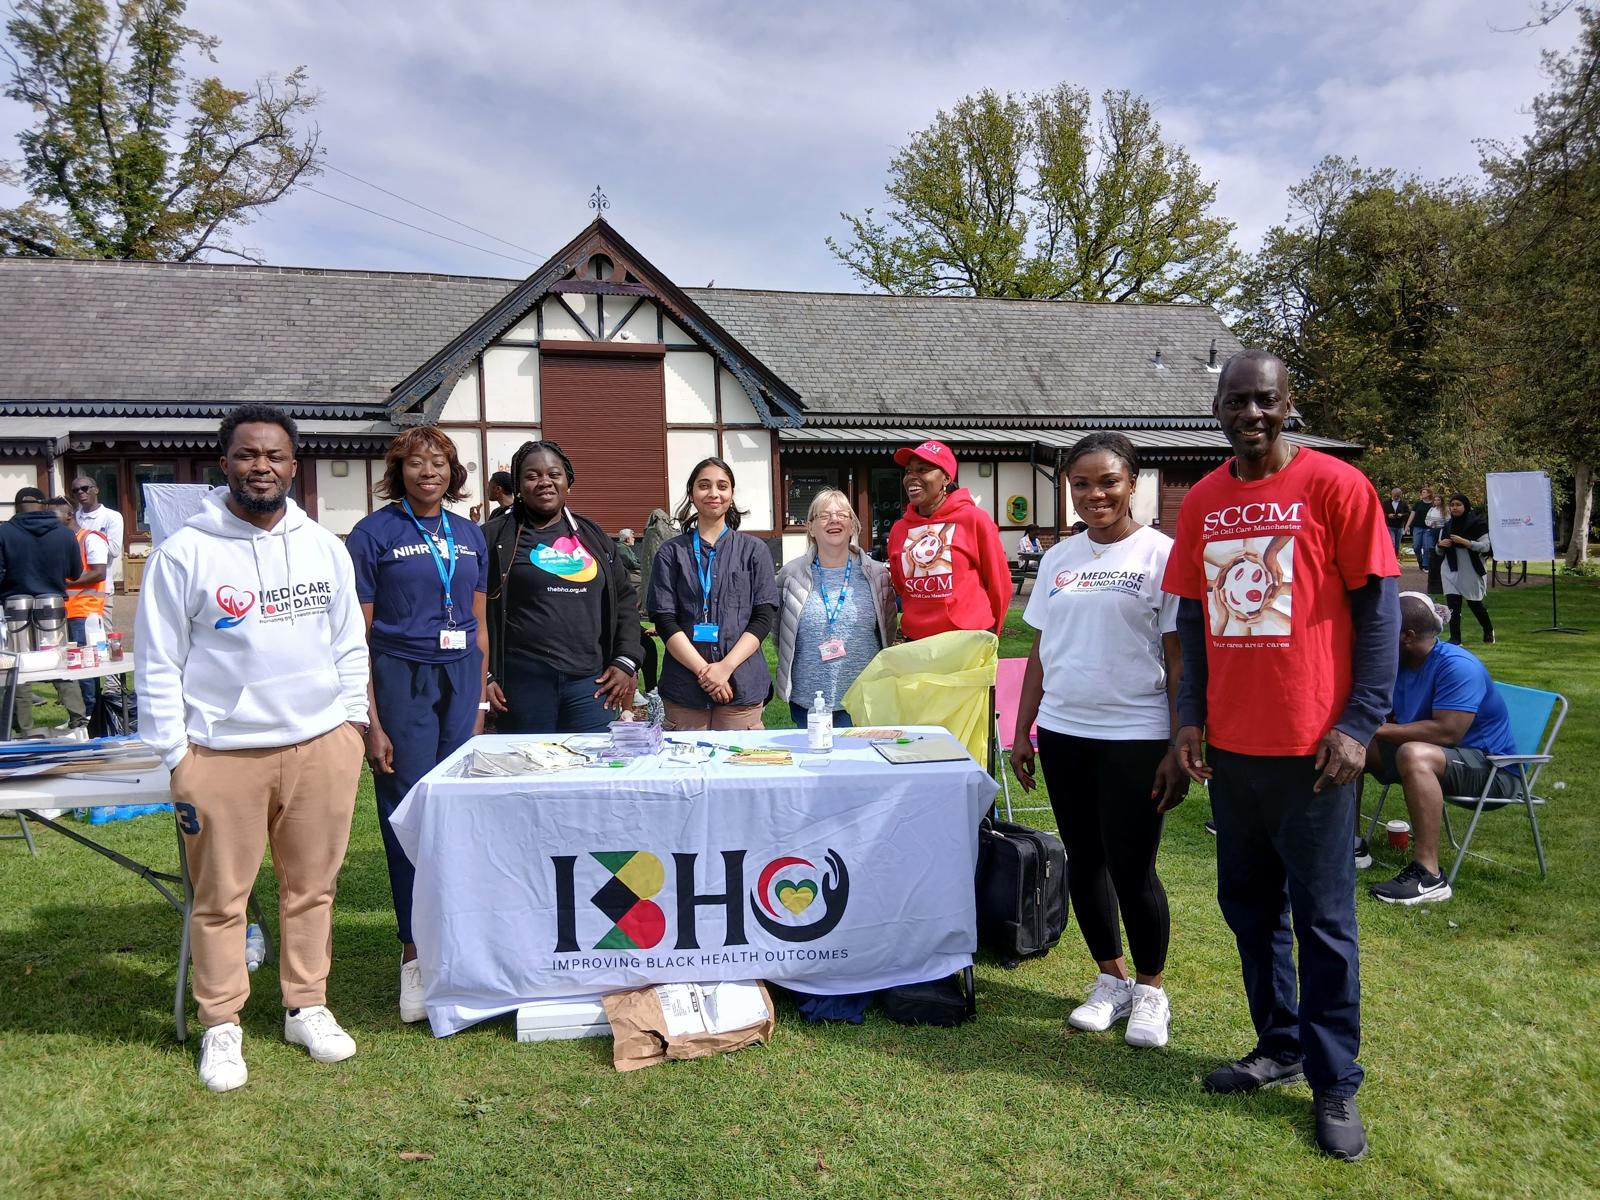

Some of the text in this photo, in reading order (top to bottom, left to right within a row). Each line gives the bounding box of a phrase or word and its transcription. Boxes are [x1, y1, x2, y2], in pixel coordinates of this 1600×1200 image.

[1203, 503, 1304, 532] SCCM
[1253, 523, 1302, 531] Manchester
[393, 543, 431, 559] NIHR
[905, 575, 953, 593] SCCM
[1077, 579, 1141, 591] FOUNDATION
[1080, 571, 1145, 583] MEDICARE
[259, 582, 331, 603] MEDICARE
[546, 586, 588, 594] thebha.org.uk
[552, 948, 849, 971] IMPROVING BLACK HEALTH OUTCOMES
